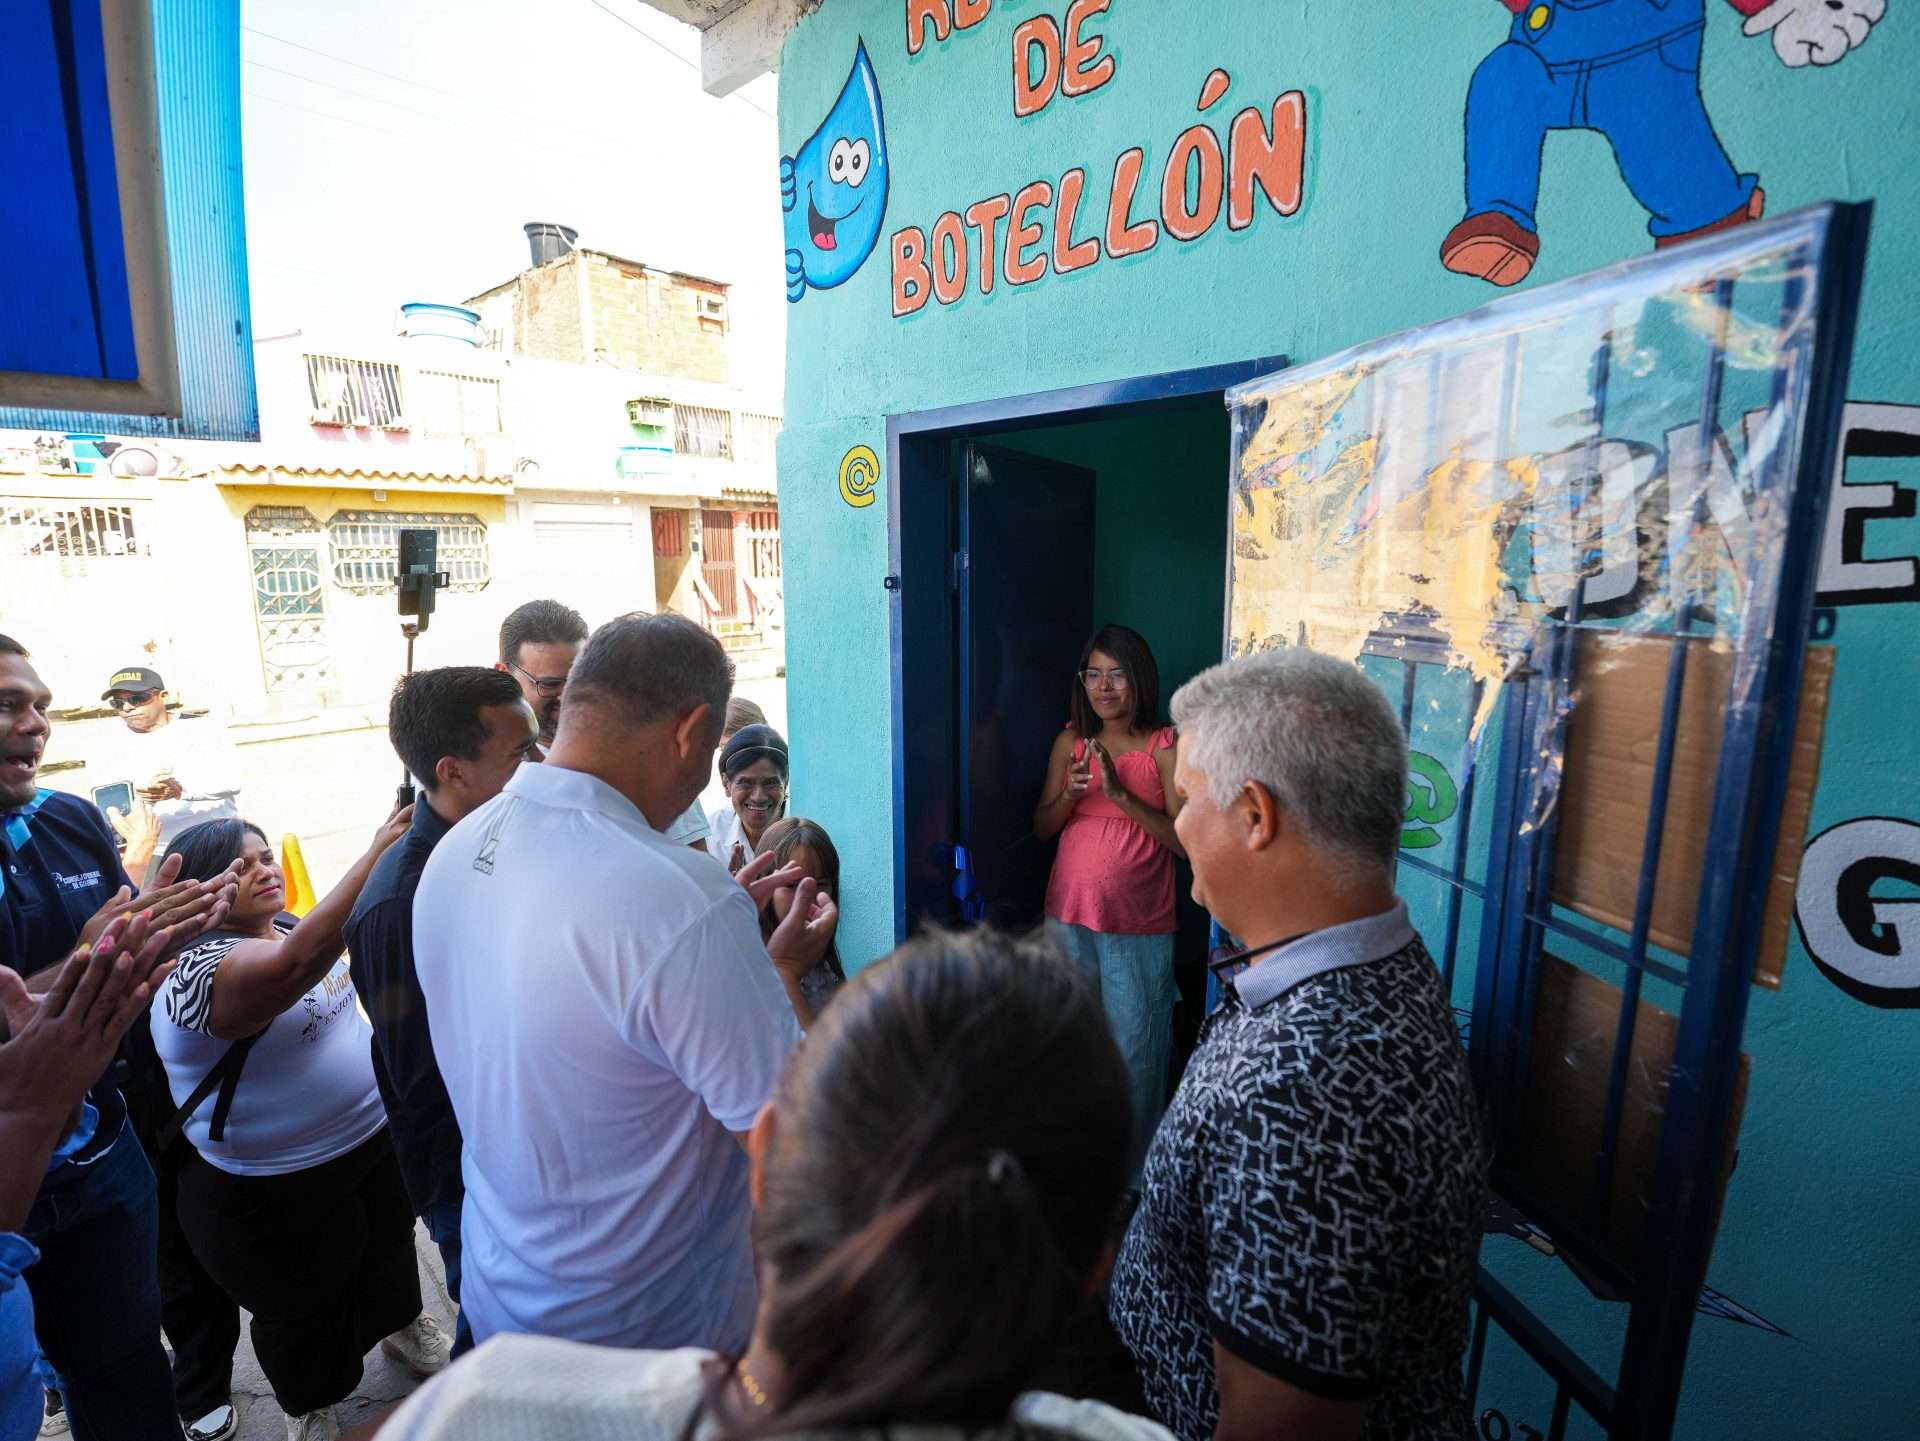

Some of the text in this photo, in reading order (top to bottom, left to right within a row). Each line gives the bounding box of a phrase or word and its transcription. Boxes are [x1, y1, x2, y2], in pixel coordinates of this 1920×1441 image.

[1012, 0, 1116, 119] DE
[890, 68, 1307, 318] BOTELLÓN
[325, 990, 354, 1025] ENJOY
